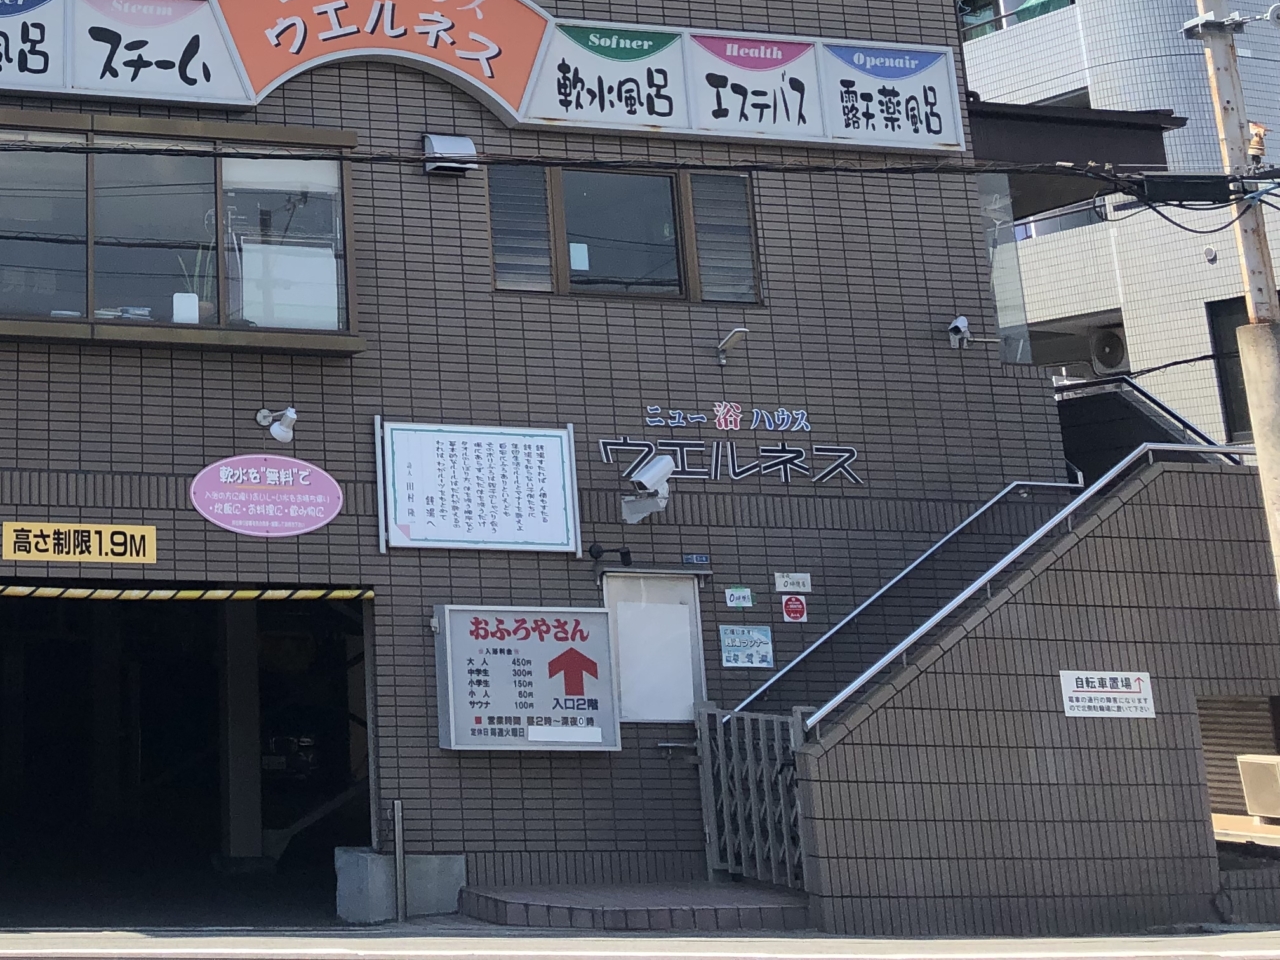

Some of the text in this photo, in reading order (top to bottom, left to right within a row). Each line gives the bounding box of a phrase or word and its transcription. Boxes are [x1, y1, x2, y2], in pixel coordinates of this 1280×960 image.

[264, 0, 502, 79] ウエルネス
[588, 32, 653, 51] Sofner
[88, 25, 211, 86] スチーム
[725, 43, 783, 60] Health
[853, 52, 920, 71] Openair
[556, 57, 674, 117] 軟水風呂
[705, 70, 807, 126] エステバス
[840, 78, 943, 136] 露天薬風呂
[599, 436, 864, 484] ウエルネス
[12, 527, 147, 558] 高さ制限1.9M
[469, 616, 590, 642] おふろやさん
[485, 647, 513, 656] 入浴料金
[511, 657, 532, 667] 450円
[467, 668, 533, 677] 中学生 300円
[468, 679, 533, 688] 小学生 150円
[1075, 676, 1132, 690] 自転車置場
[468, 700, 534, 710] サウナ 100円
[552, 697, 599, 711] 入口2階
[487, 716, 521, 726] 営業時間
[470, 727, 525, 738] 定休日 毎週火曜日
